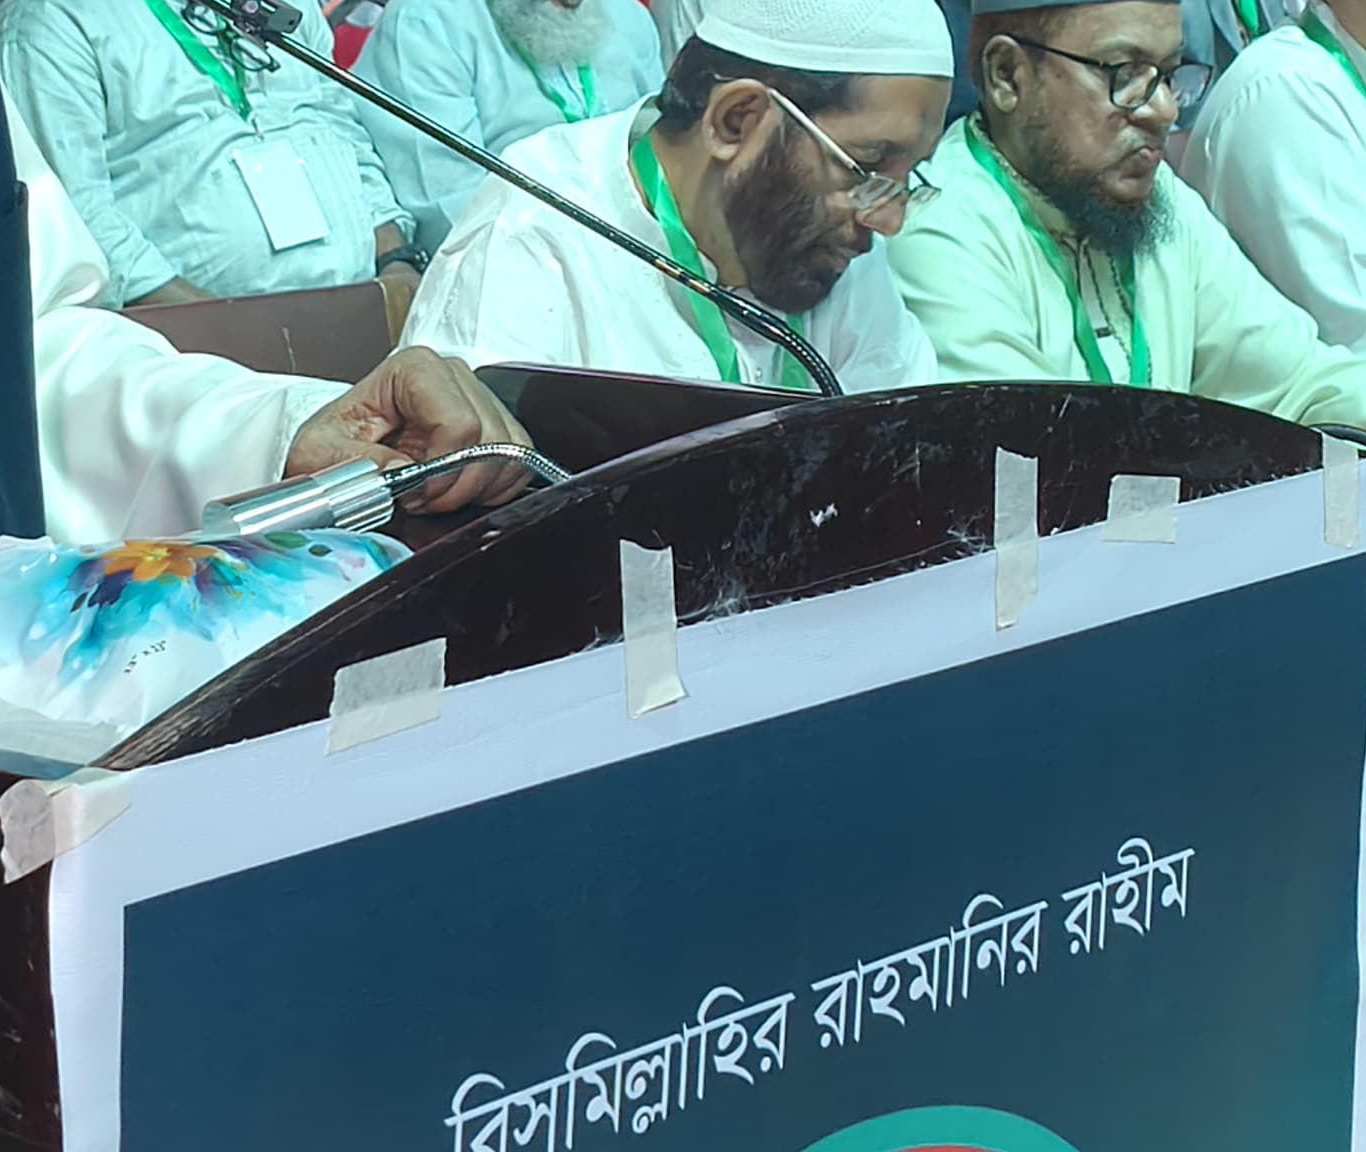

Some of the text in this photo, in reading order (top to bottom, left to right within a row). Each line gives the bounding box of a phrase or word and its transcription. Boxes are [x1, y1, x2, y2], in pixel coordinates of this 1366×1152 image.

[444, 837, 1195, 1152] বিসমিল্লাহির রাহমানির রাহীম
